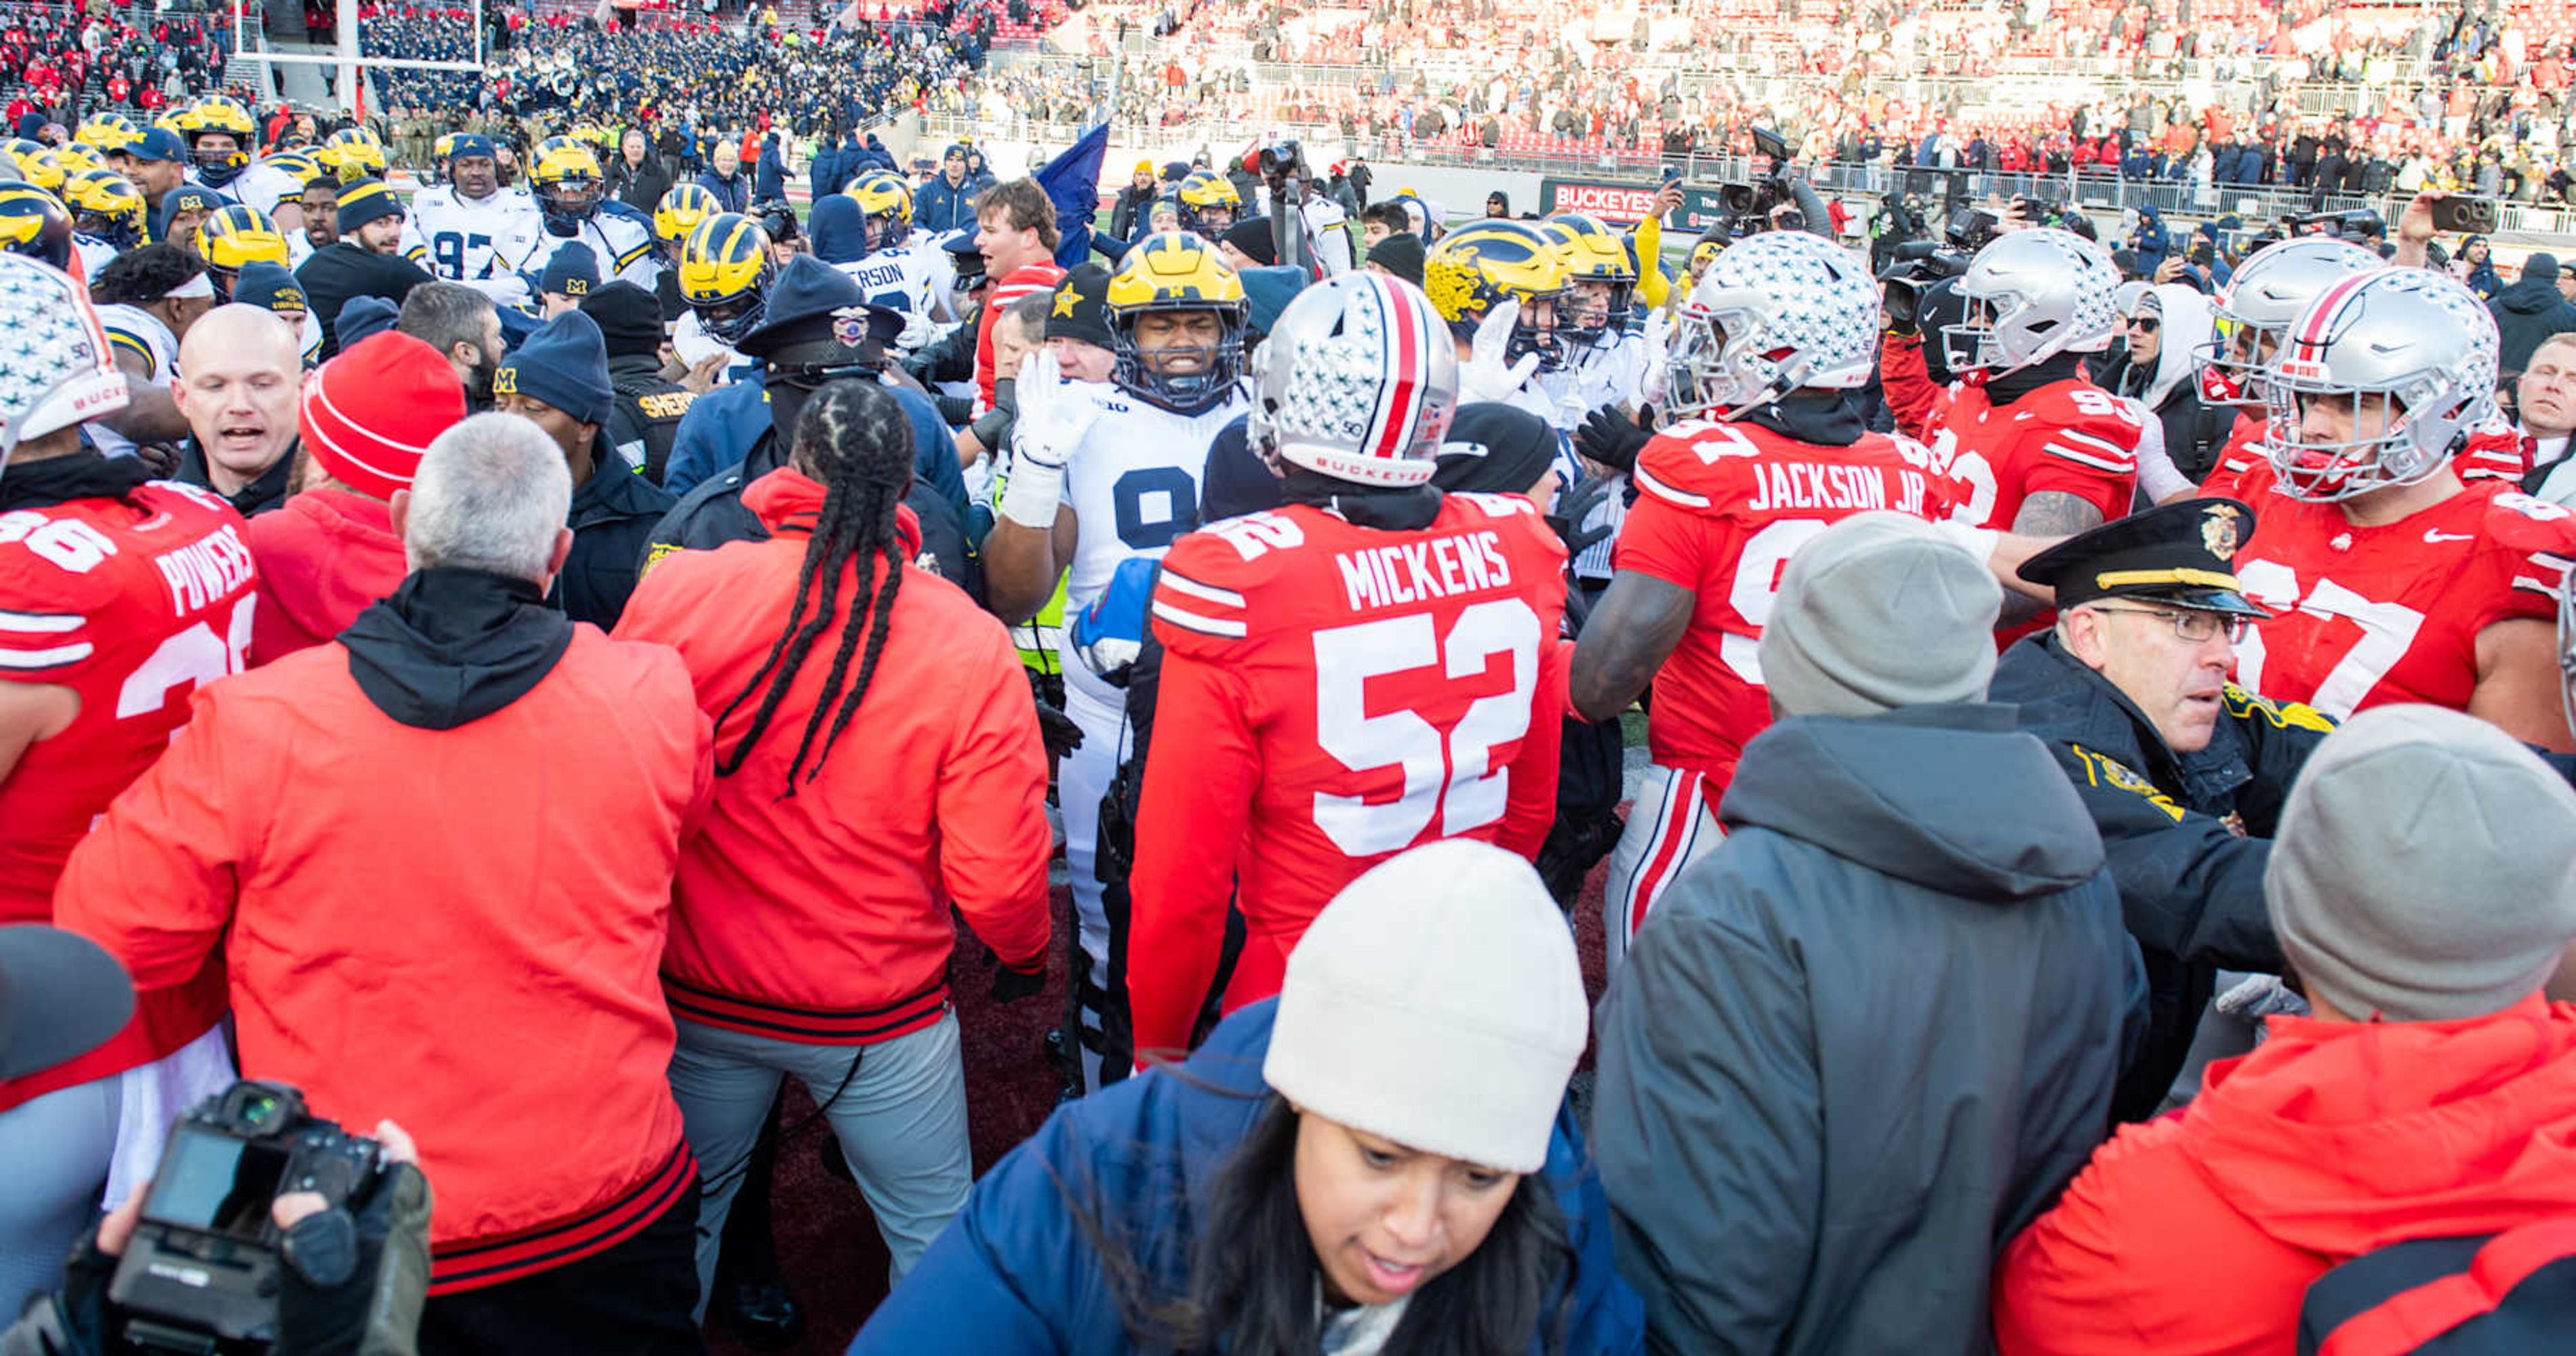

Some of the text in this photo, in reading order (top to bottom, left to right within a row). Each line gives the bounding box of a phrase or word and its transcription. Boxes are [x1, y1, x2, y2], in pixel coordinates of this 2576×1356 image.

[434, 231, 494, 281] 97
[567, 278, 587, 294] M
[493, 367, 517, 393] M
[1748, 462, 1926, 514] JACKSON JR
[155, 523, 254, 618] POWERS
[1335, 531, 1511, 611] MICKENS
[1312, 597, 1543, 857] 52
